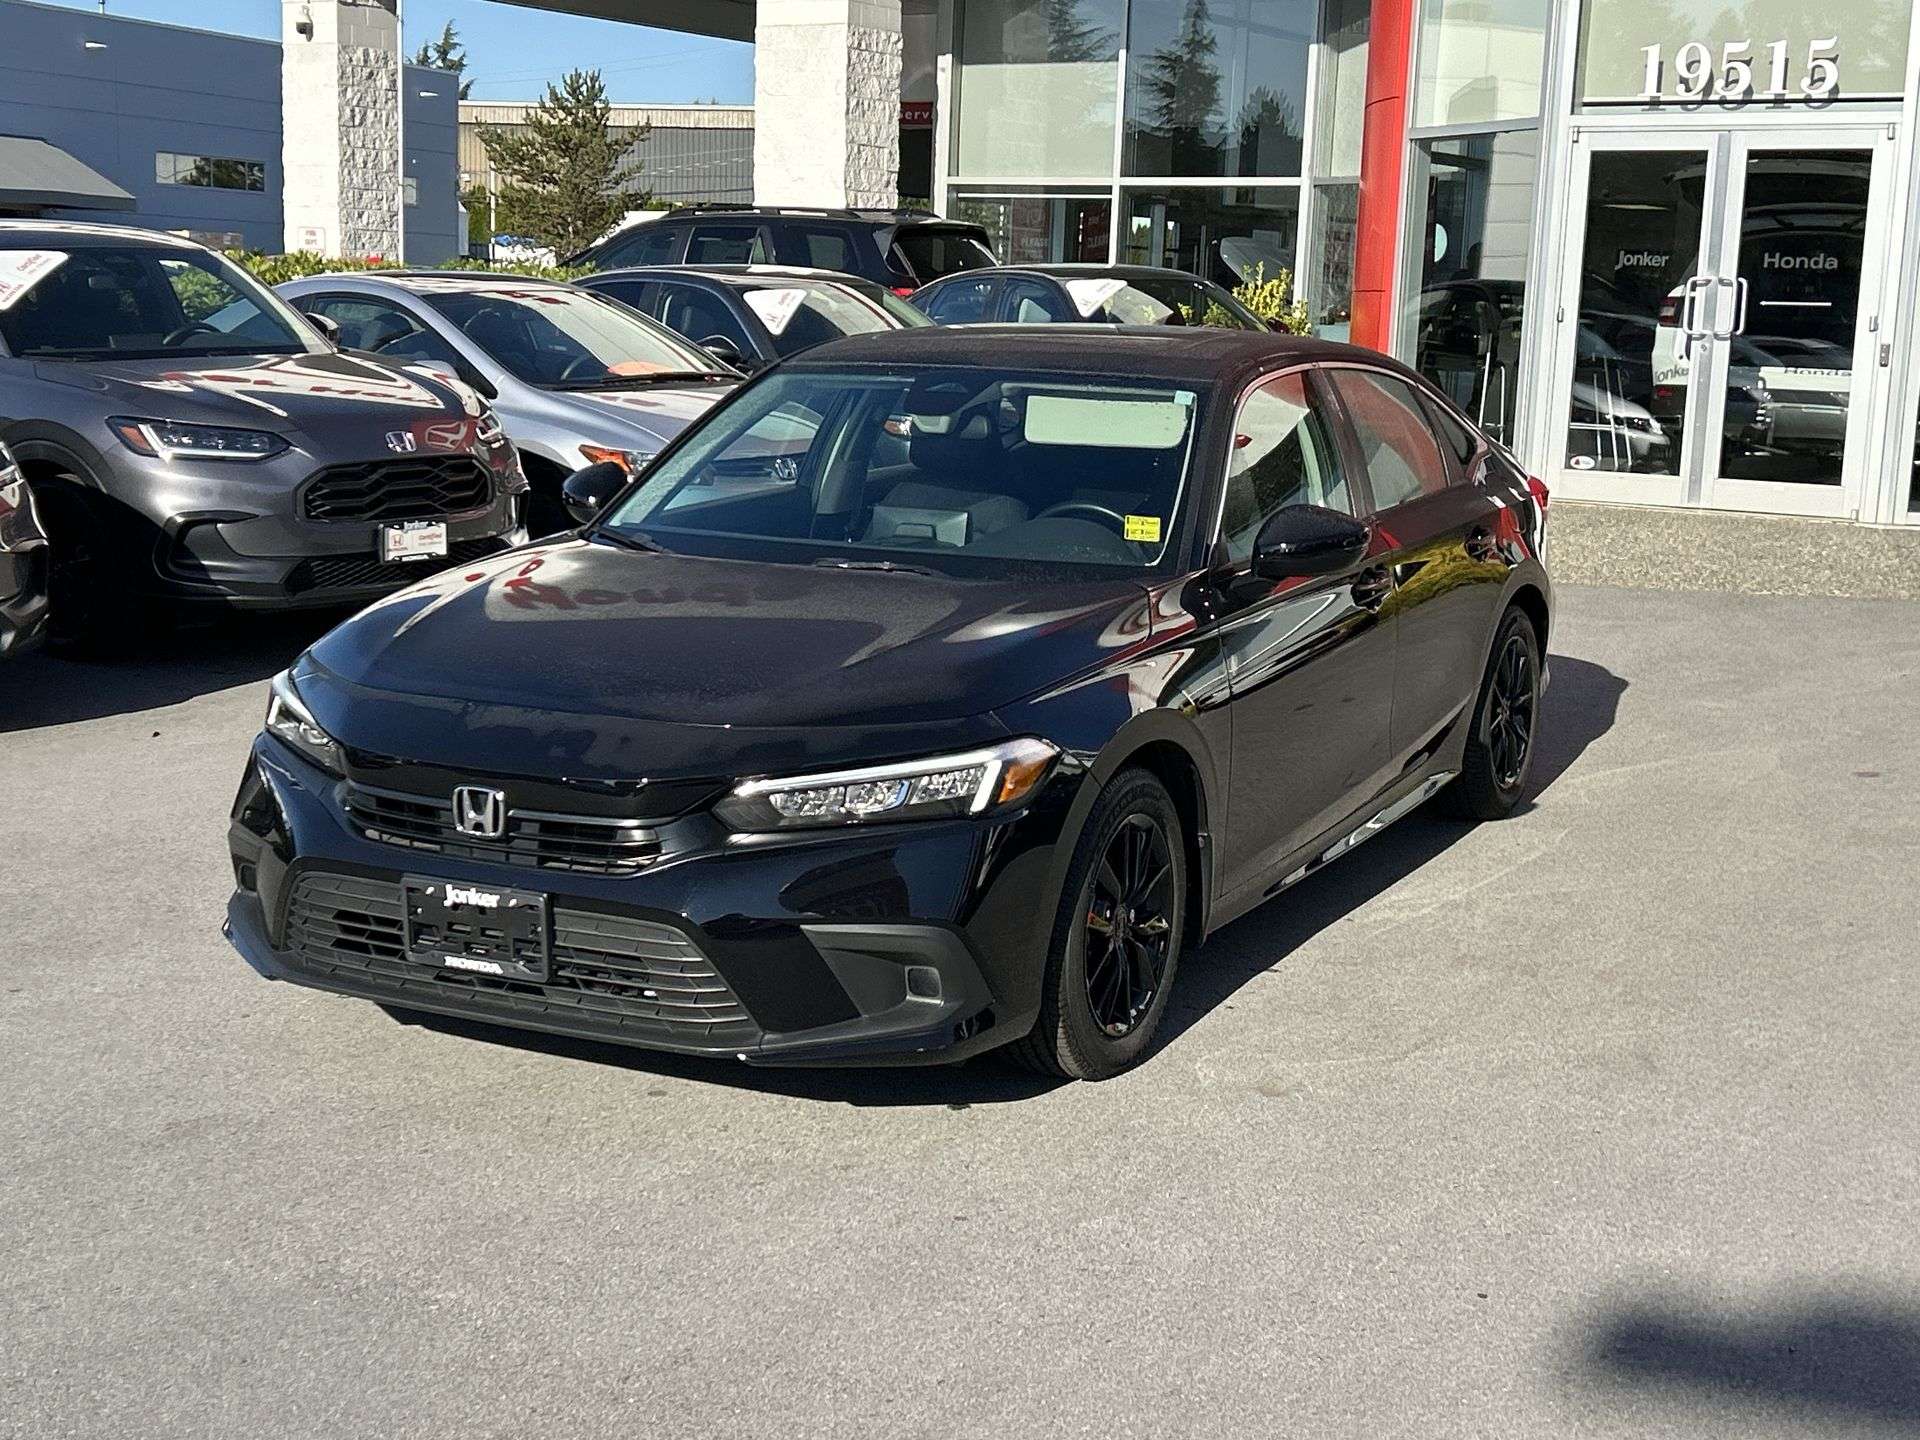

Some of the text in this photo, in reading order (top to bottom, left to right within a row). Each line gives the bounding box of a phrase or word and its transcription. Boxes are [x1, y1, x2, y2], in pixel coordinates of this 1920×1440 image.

[1636, 36, 1839, 98] 19515
[1614, 251, 1839, 271] Jonker Honda
[443, 884, 500, 908] Jonker
